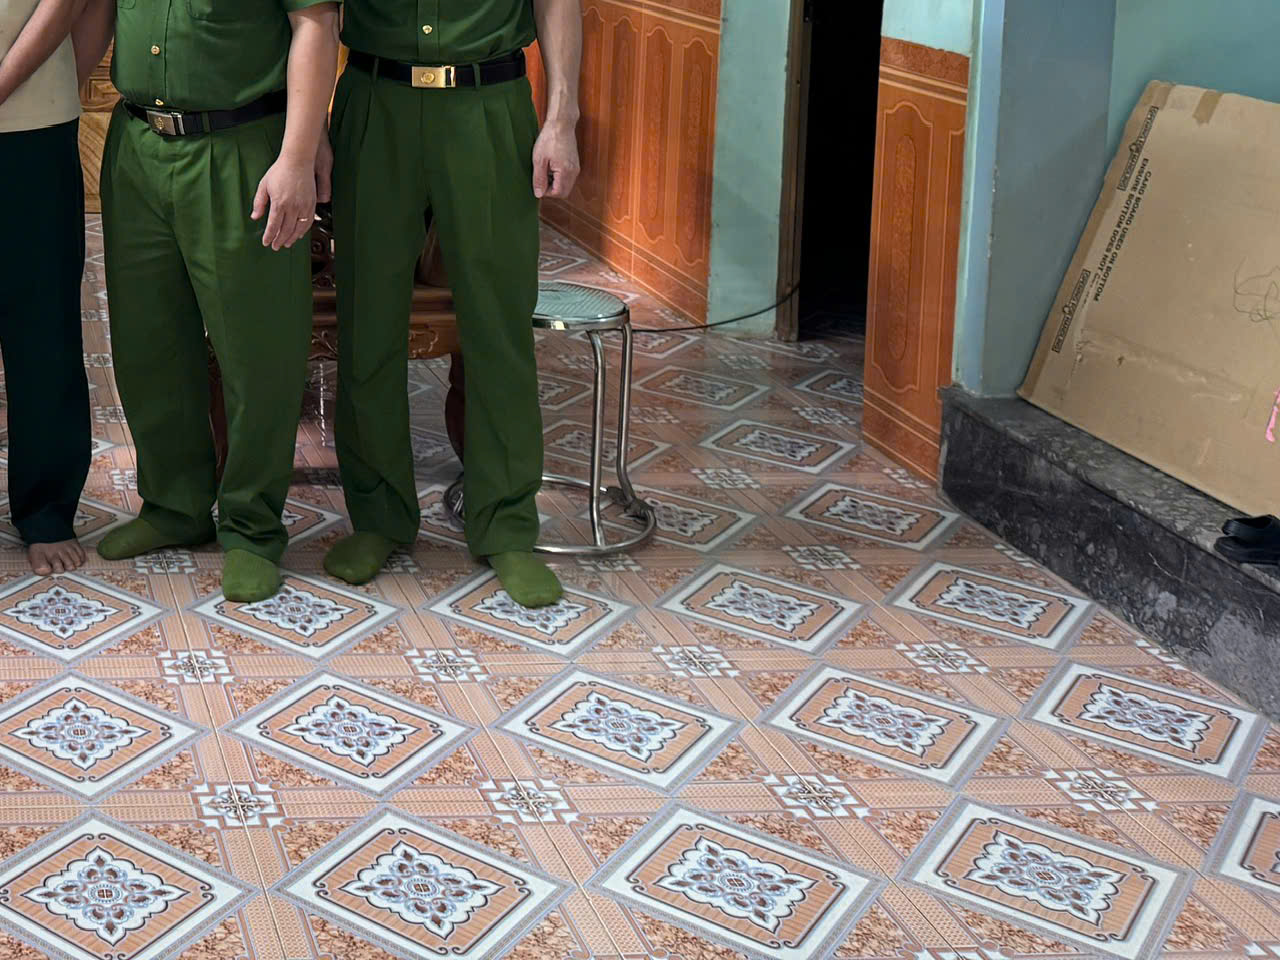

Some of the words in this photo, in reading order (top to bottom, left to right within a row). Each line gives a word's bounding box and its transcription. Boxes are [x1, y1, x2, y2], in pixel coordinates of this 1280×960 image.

[1130, 158, 1150, 193] ENSURE
[1137, 170, 1152, 196] CARD
[1115, 193, 1135, 229] BOTTOM
[1125, 196, 1142, 226] BOARD
[1105, 229, 1120, 254] DOES
[1114, 226, 1129, 251] USED
[1097, 254, 1109, 272] NOT
[1108, 251, 1119, 265] ON
[1092, 265, 1113, 302] BOTTOM
